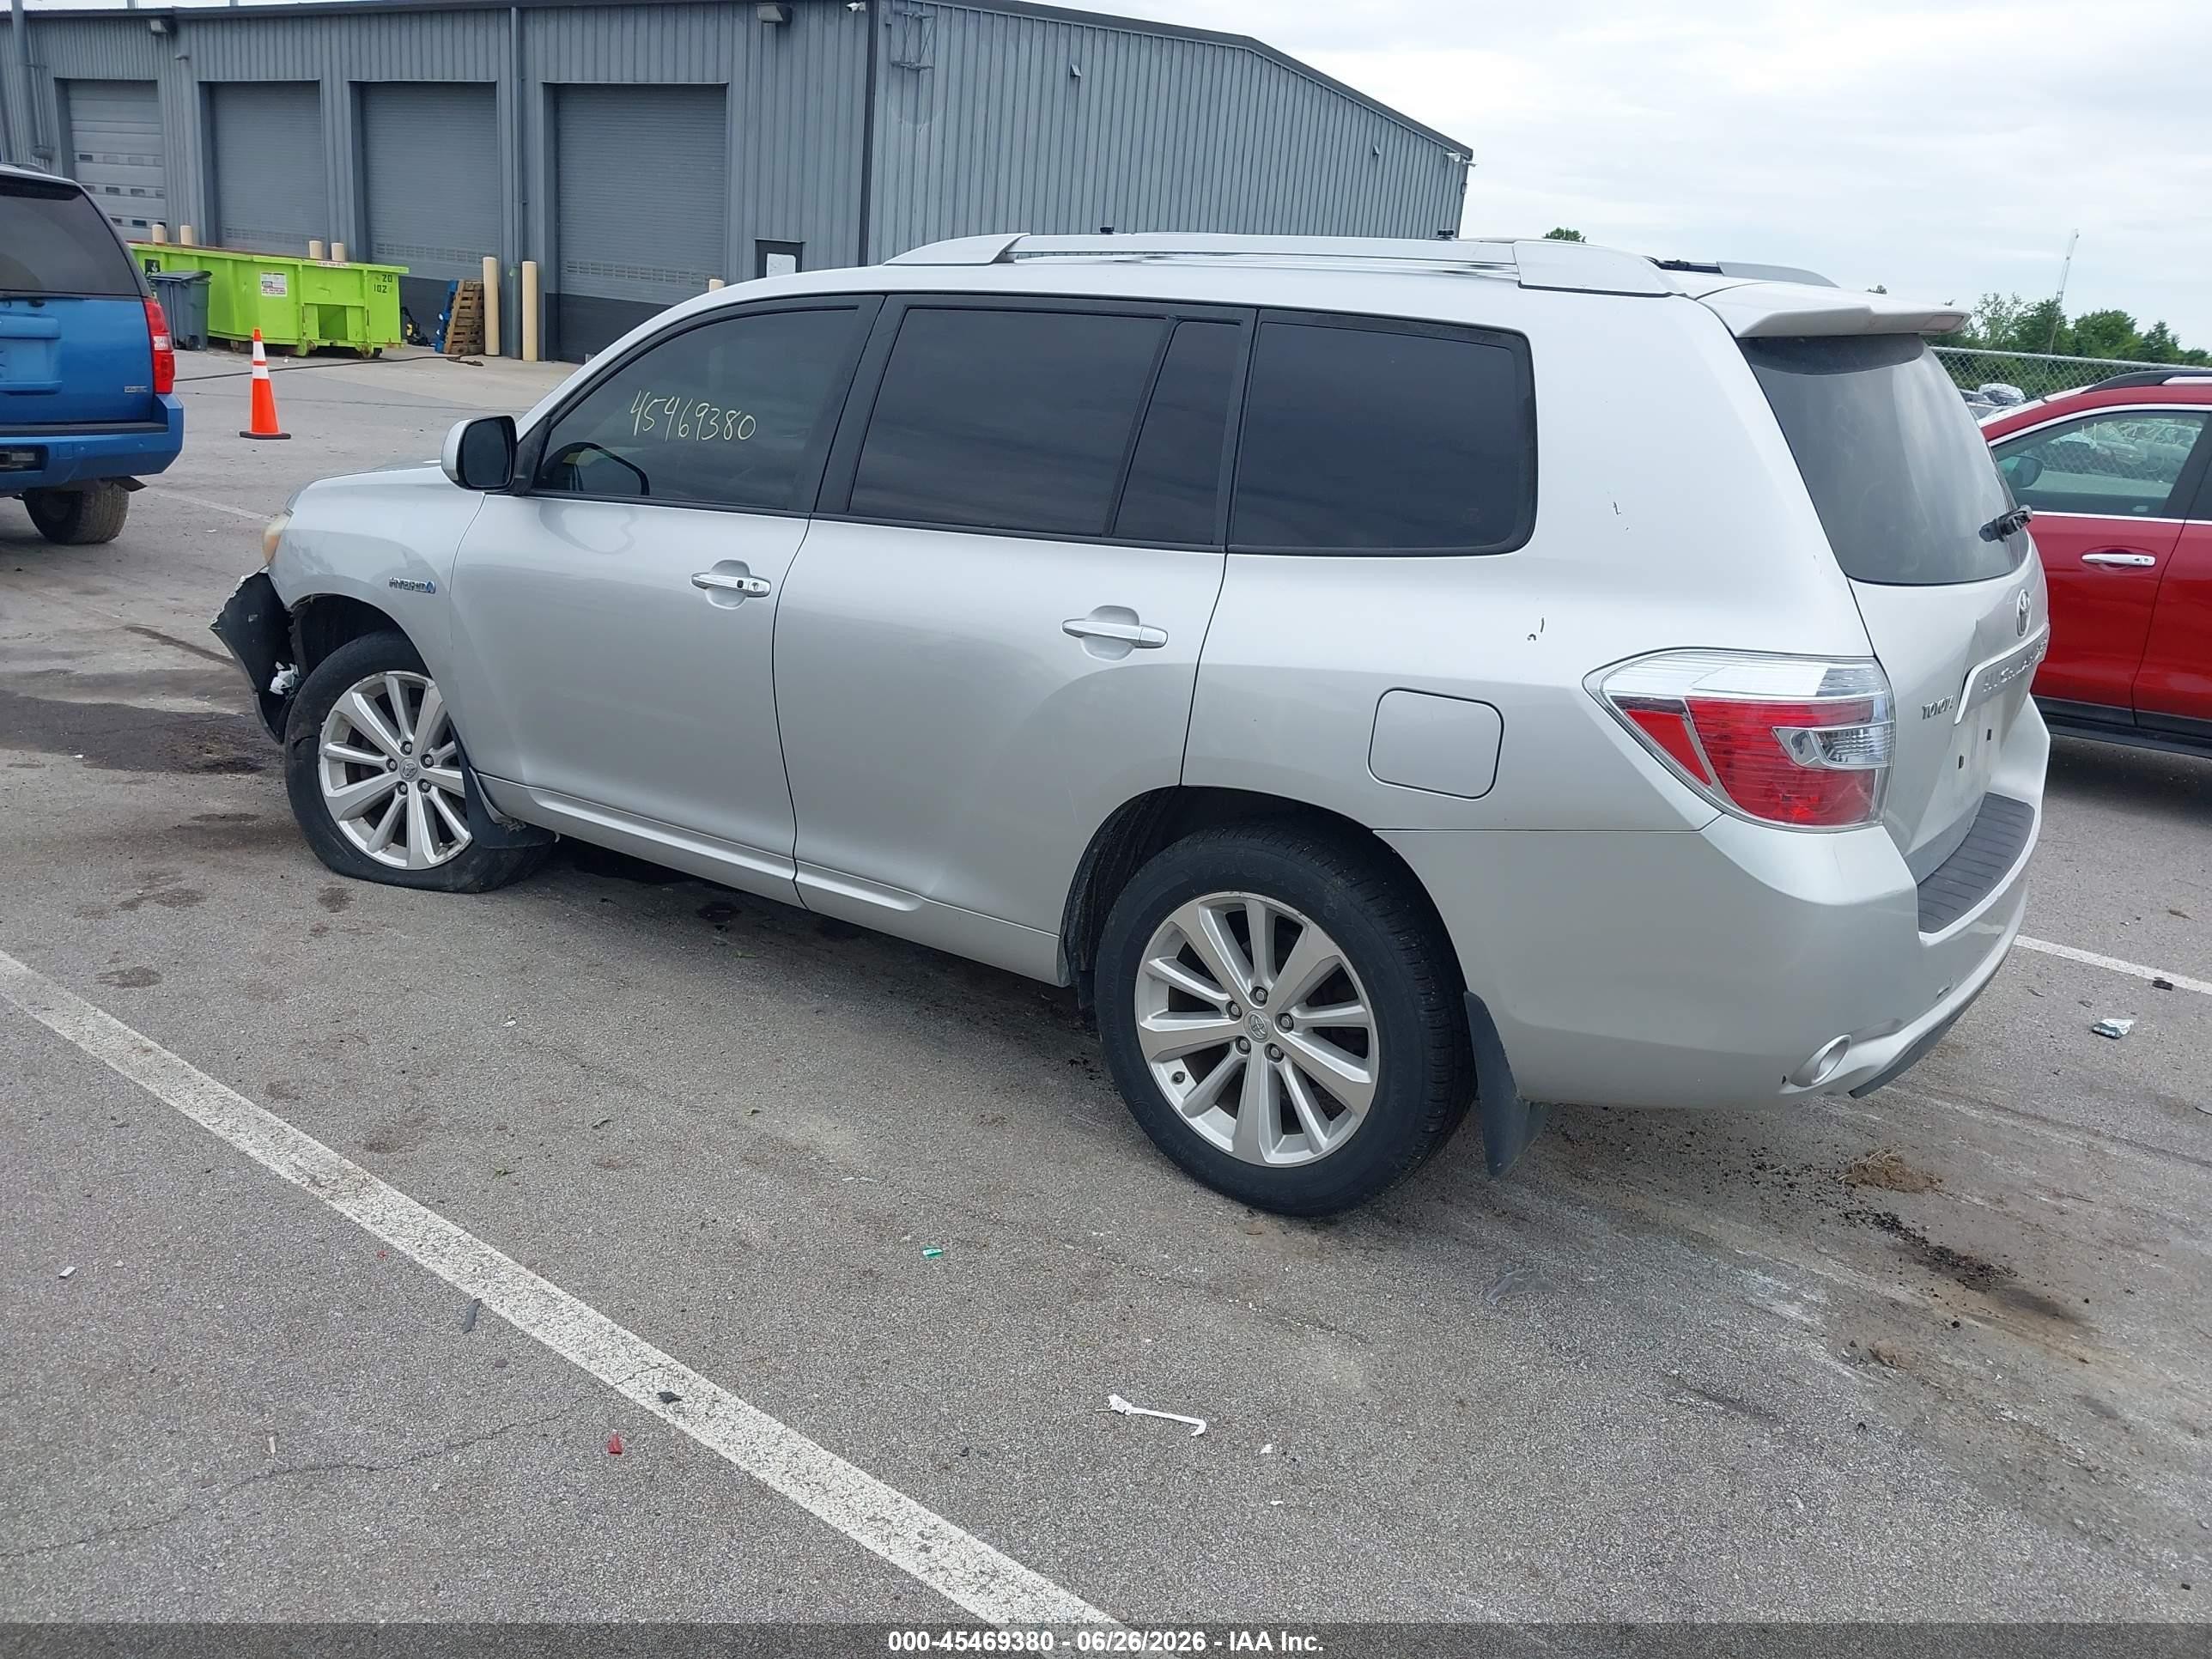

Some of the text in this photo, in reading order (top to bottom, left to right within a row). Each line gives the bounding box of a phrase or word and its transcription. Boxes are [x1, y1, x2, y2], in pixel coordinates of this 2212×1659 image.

[381, 274, 392, 283] 20
[373, 283, 387, 294] 102
[630, 390, 757, 442] 45469380
